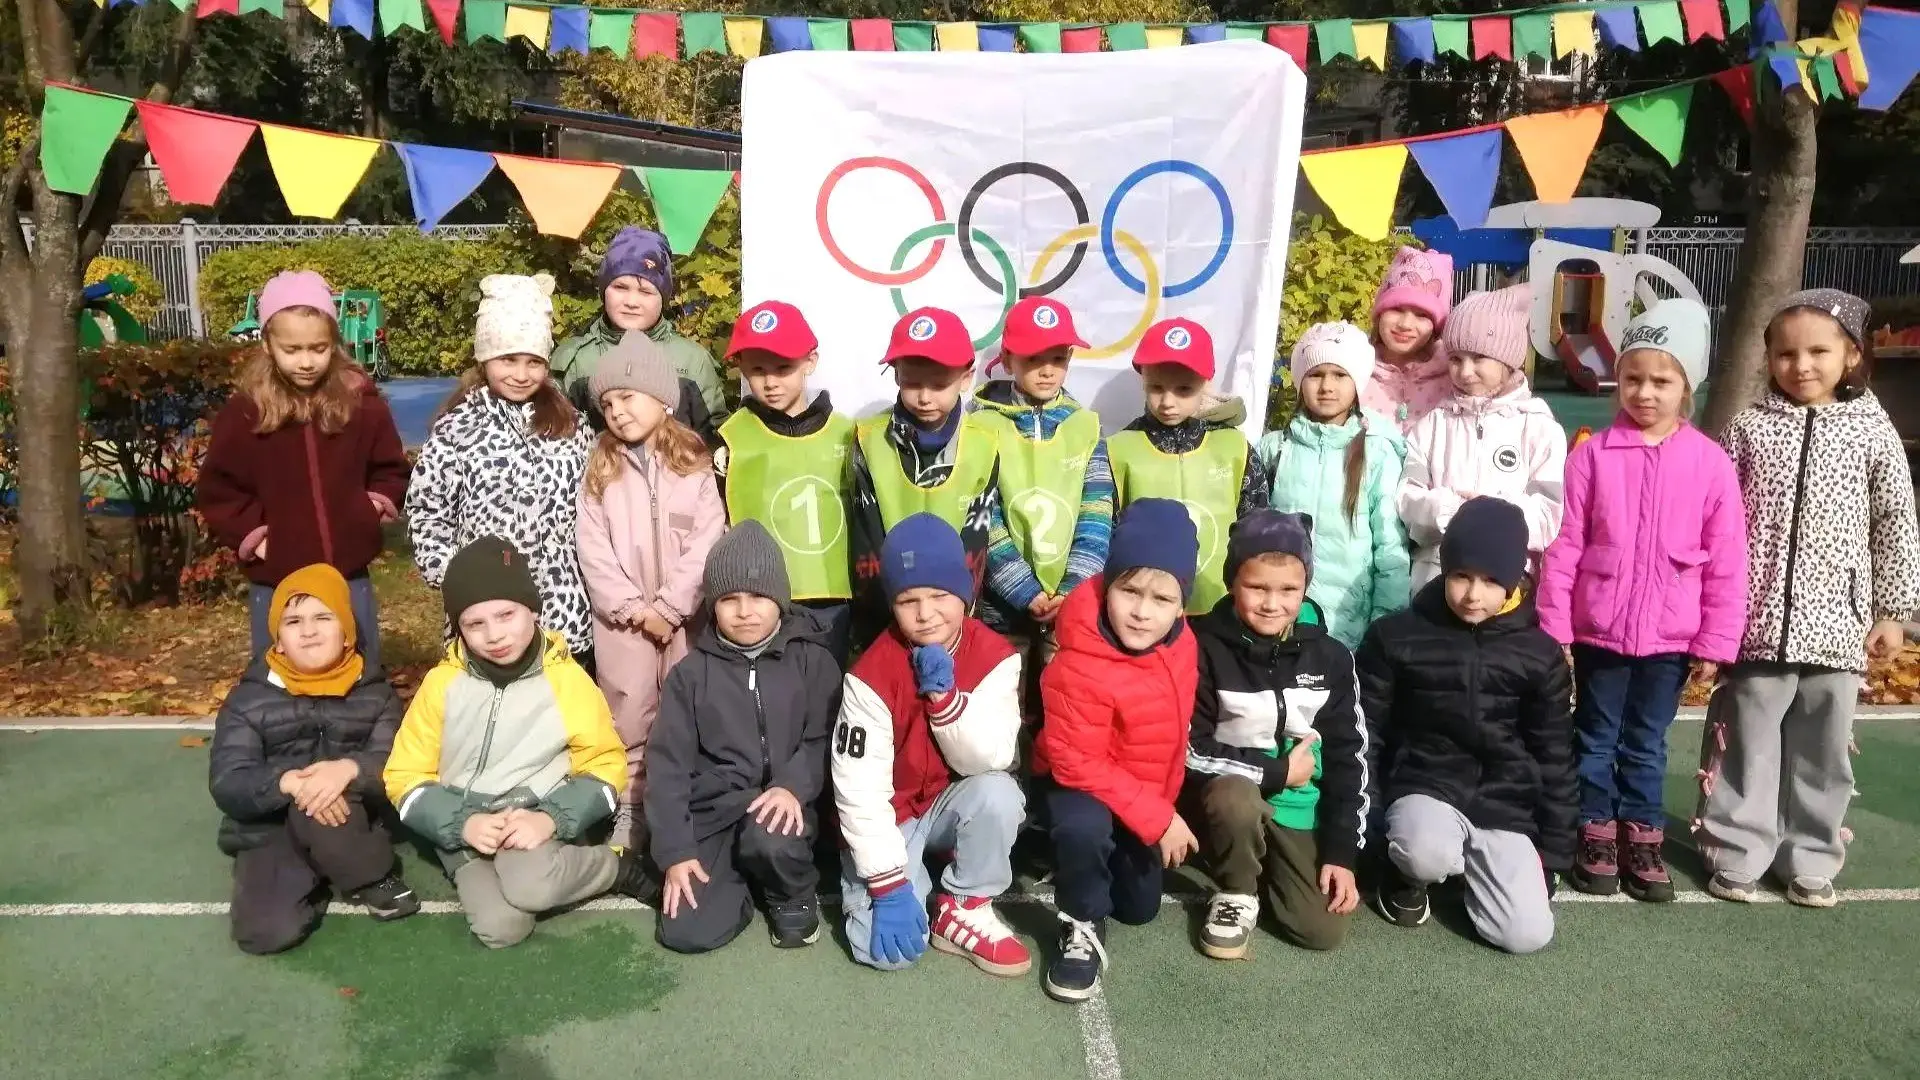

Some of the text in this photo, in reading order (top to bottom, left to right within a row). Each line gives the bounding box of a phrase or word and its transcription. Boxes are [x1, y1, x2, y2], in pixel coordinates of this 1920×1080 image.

[791, 483, 822, 545] 1
[1024, 493, 1058, 555] 2
[836, 721, 867, 759] 98
